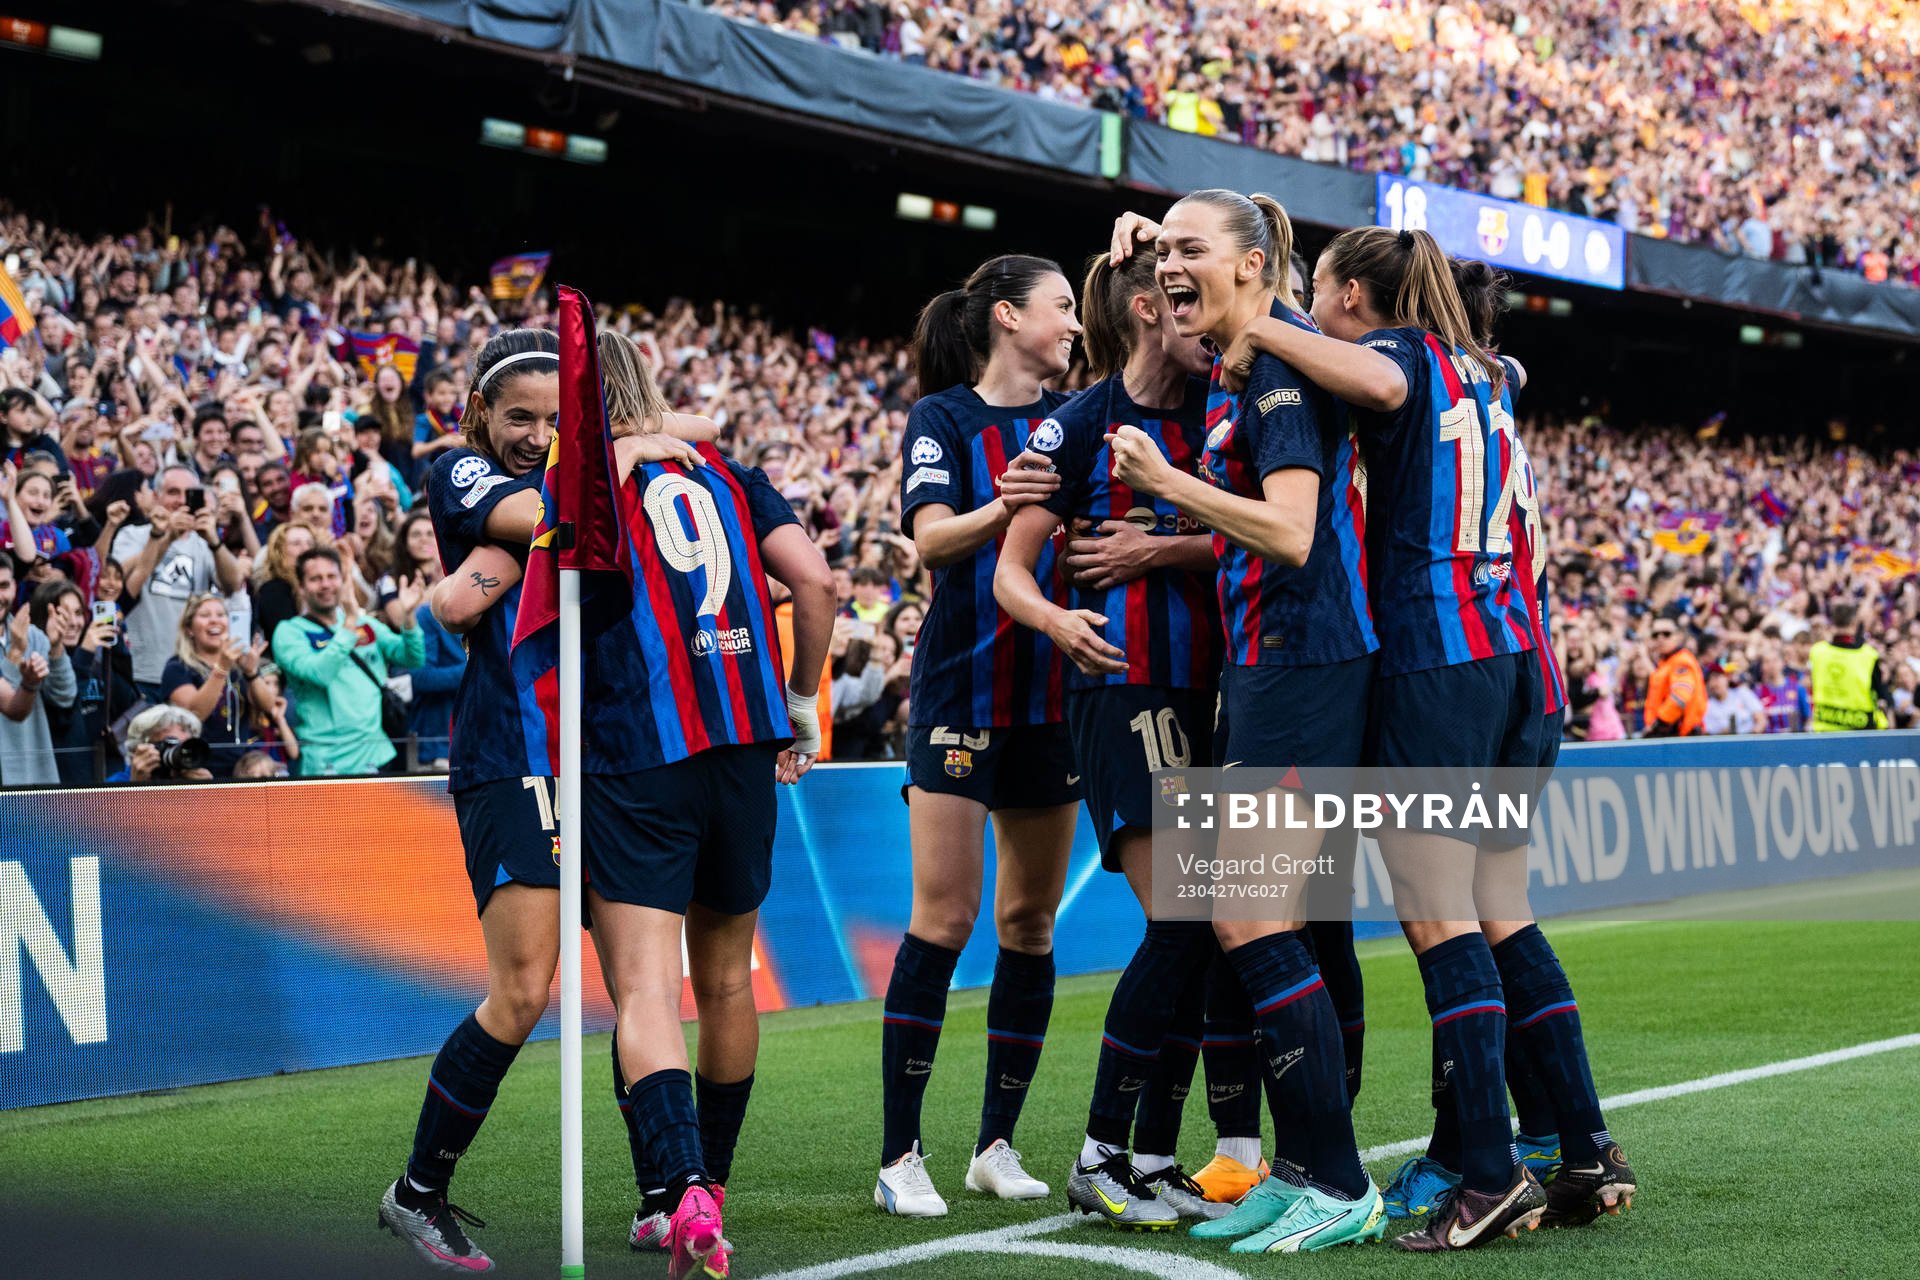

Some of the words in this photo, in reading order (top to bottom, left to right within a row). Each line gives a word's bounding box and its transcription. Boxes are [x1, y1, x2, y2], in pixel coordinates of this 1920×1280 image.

[1385, 181, 1427, 231] 18
[1257, 391, 1301, 413] BIMBO
[643, 473, 732, 617] 9
[1129, 707, 1191, 773] 10
[1635, 769, 1737, 876] WIN
[1741, 762, 1859, 862] YOUR
[1859, 757, 1920, 849] VIP
[1210, 1083, 1245, 1093] barça
